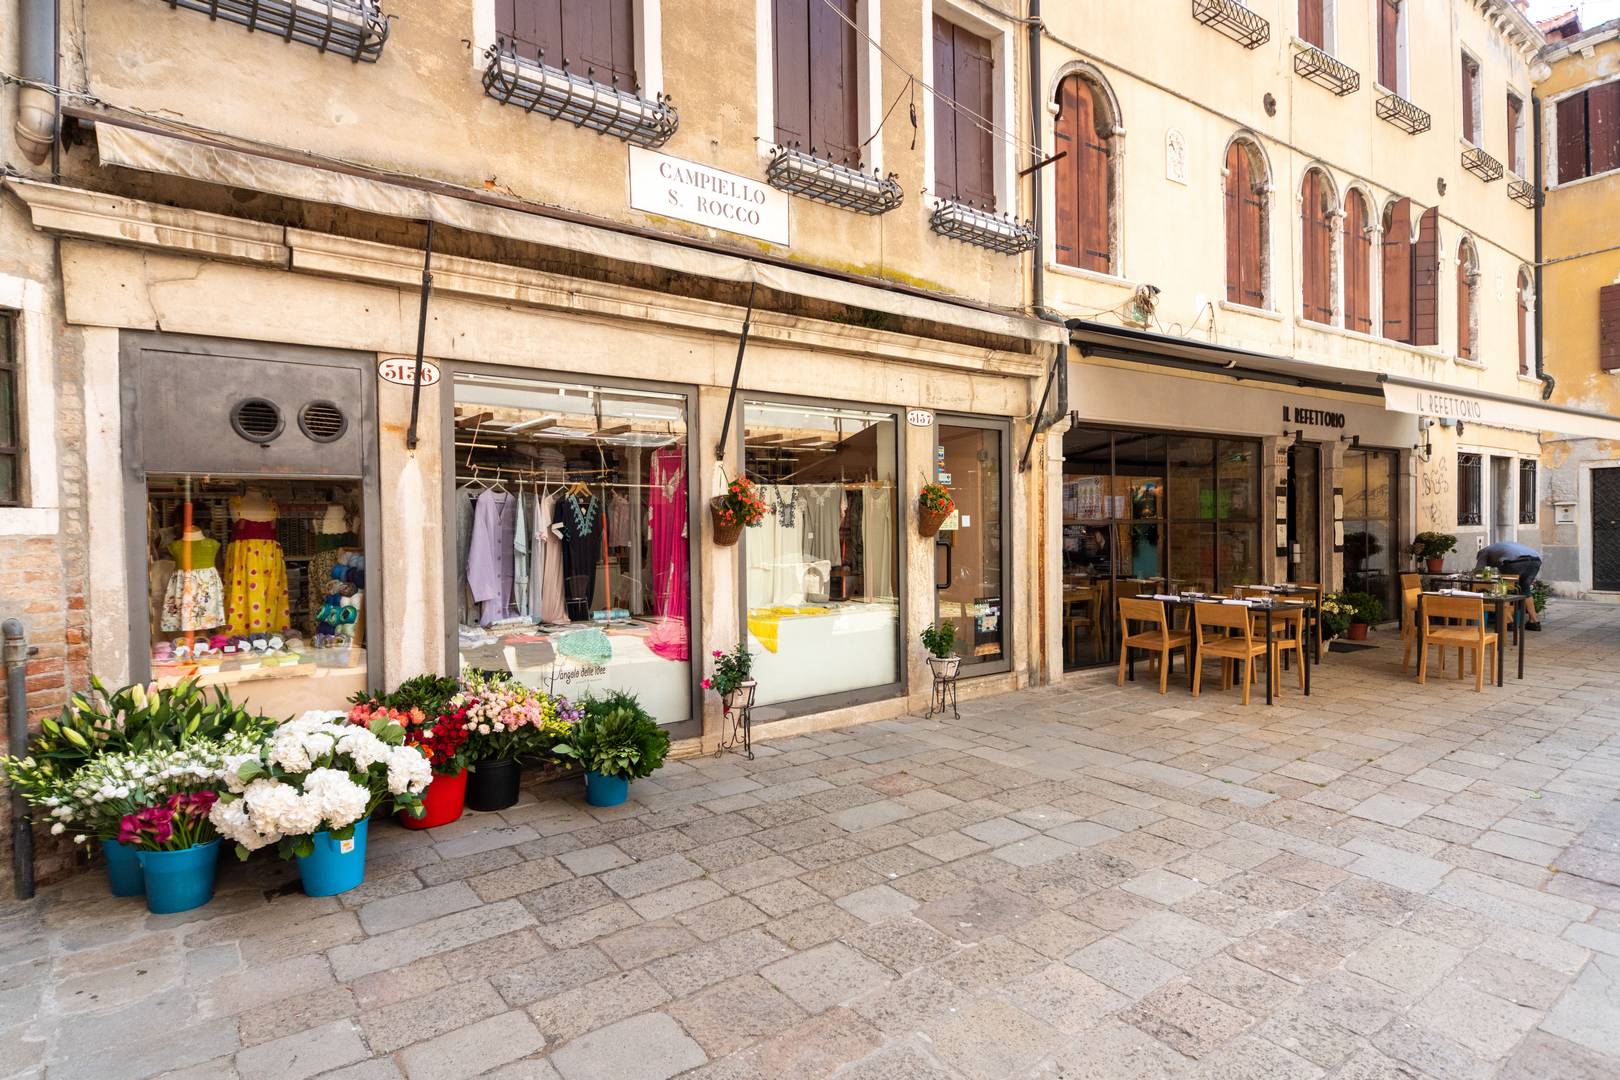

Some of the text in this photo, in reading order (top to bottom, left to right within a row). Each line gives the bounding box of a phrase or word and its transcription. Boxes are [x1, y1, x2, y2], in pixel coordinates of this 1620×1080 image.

[659, 161, 766, 205] CAMPIELLO
[668, 188, 760, 225] S. ROCCO
[1283, 405, 1345, 428] IL REFETTORIO
[1416, 392, 1481, 418] IL REFETTORIO
